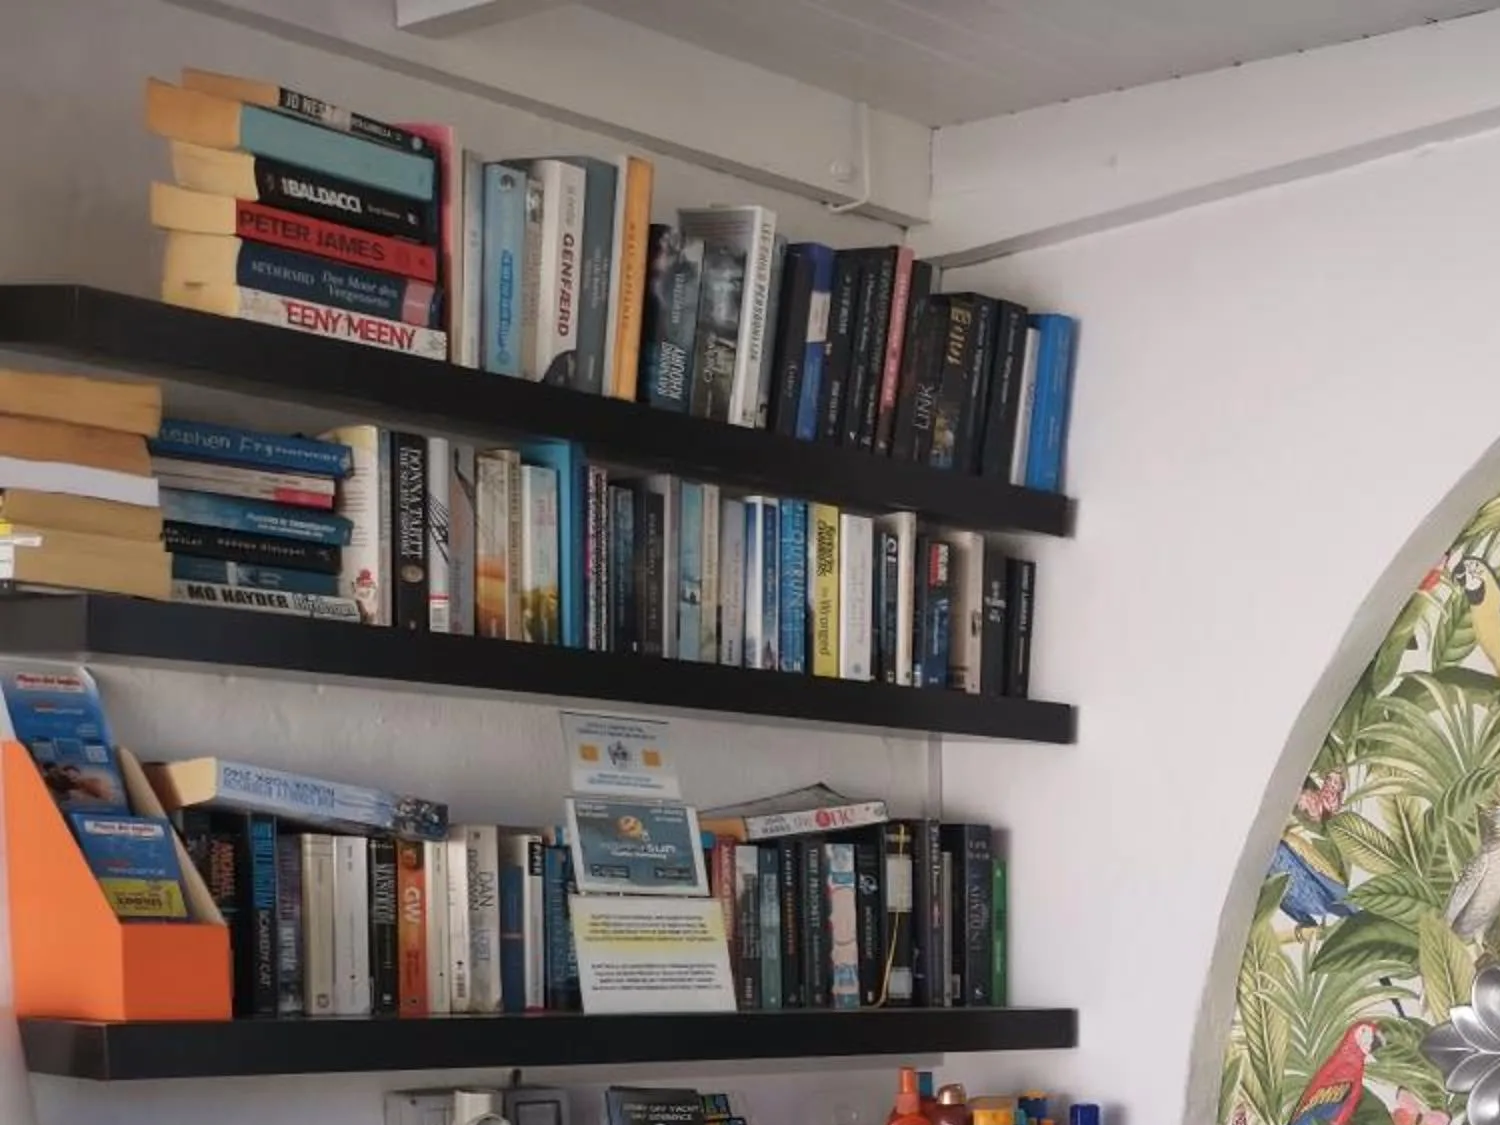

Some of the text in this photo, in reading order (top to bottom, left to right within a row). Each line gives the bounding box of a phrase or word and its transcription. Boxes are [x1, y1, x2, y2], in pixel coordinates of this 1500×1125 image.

[239, 210, 386, 262] PETER JAMES
[557, 232, 575, 338] GENFÆRD
[287, 302, 416, 351] EENY MEENY
[913, 383, 935, 430] LINK
[409, 448, 423, 503] DONNA
[187, 584, 217, 602] MO
[221, 586, 289, 609] HAYDER
[818, 599, 832, 656] Wronged
[403, 888, 422, 925] GW
[478, 870, 494, 907] DAN
